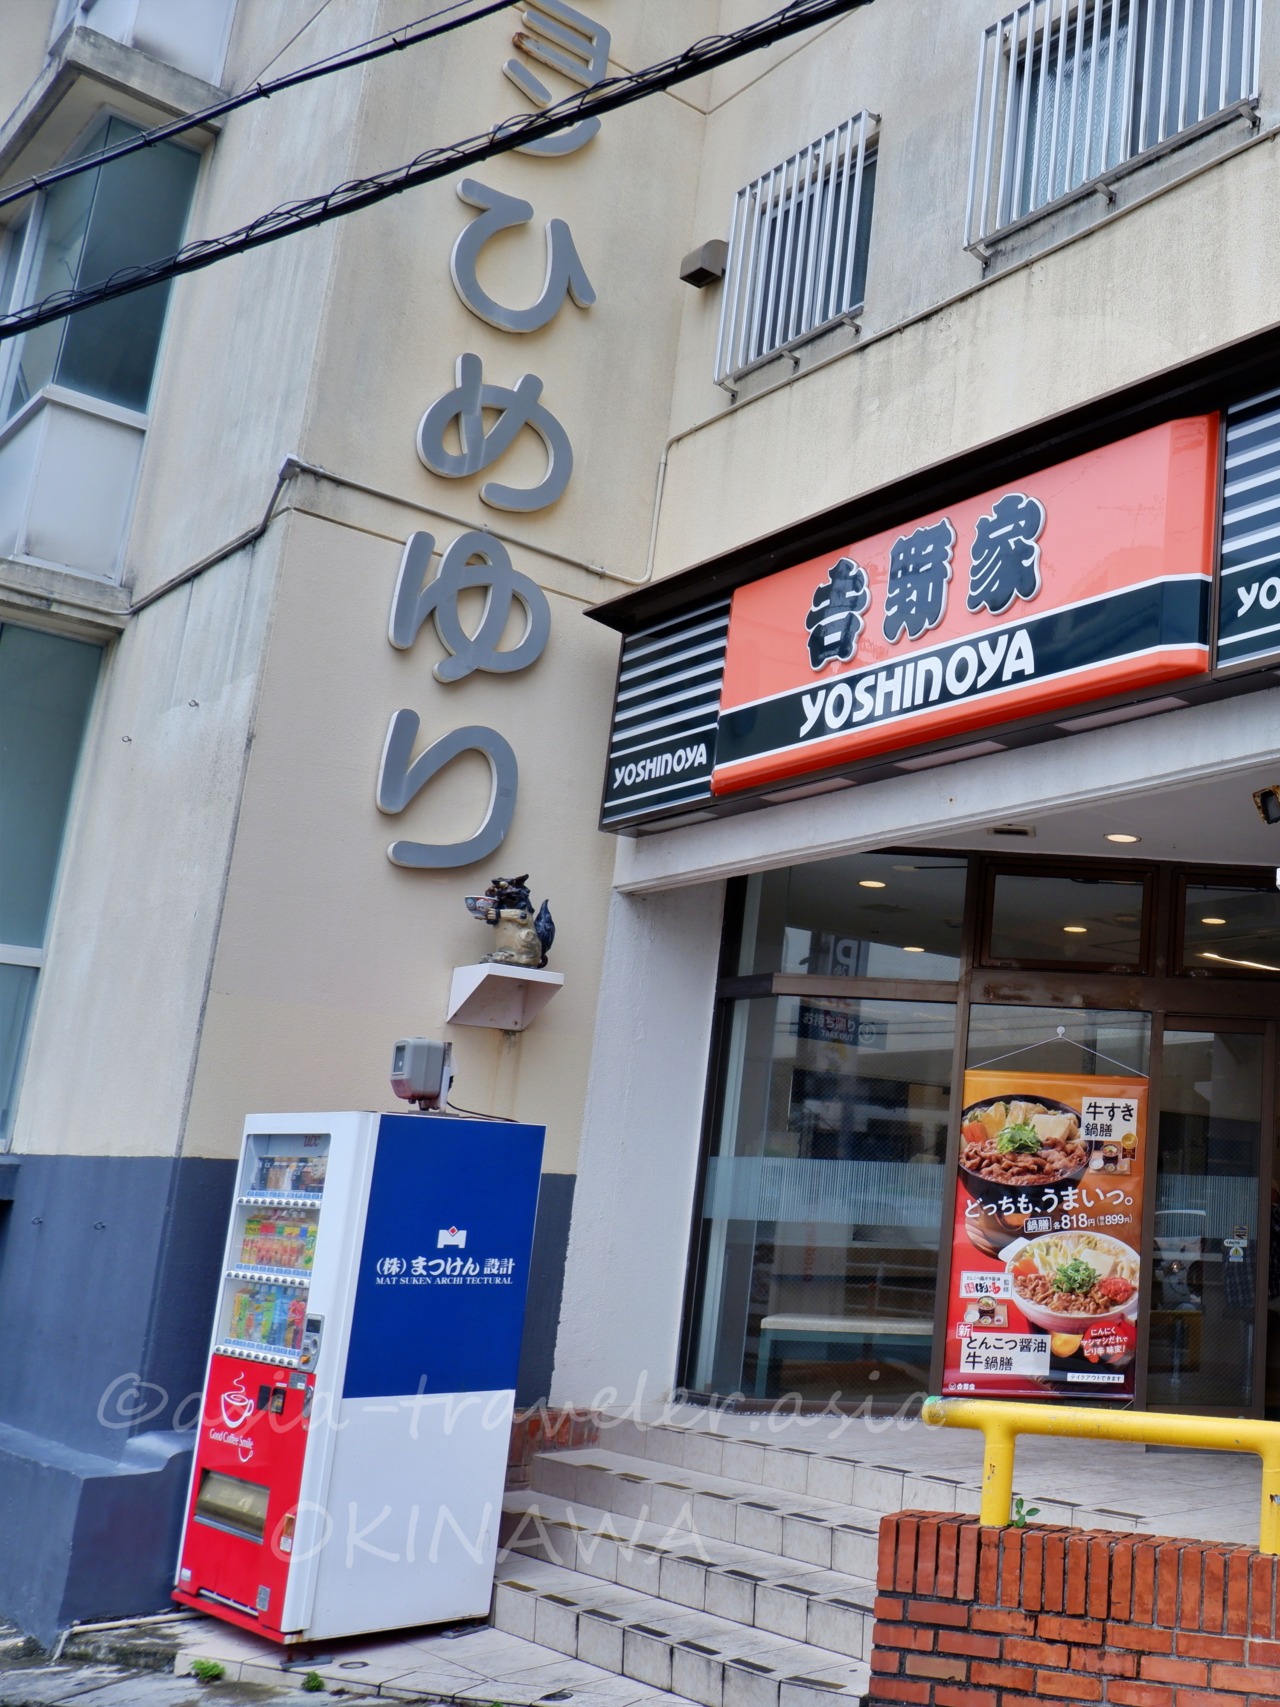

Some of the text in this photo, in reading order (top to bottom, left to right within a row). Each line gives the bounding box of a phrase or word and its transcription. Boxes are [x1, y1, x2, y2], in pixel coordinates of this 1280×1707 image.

[804, 492, 1046, 672] 吉野家
[800, 629, 1035, 738] YOSHINOYA
[612, 742, 707, 789] YOSHINOYA
[821, 1030, 854, 1041] TAKE OUT
[1085, 1101, 1134, 1122] 牛すき
[1084, 1123, 1113, 1138] 鍋膳
[965, 1186, 1133, 1218] どっちも、うまいっ。
[411, 1256, 480, 1276] まつけん
[483, 1257, 515, 1275] 設計
[400, 1276, 433, 1285] SUKEN
[958, 1323, 971, 1337] 新
[1090, 1327, 1116, 1336] にんにく
[966, 1336, 1047, 1354] とんこつ醤油
[965, 1351, 1014, 1371] 牛鍋膳
[209, 1427, 223, 1442] Good
